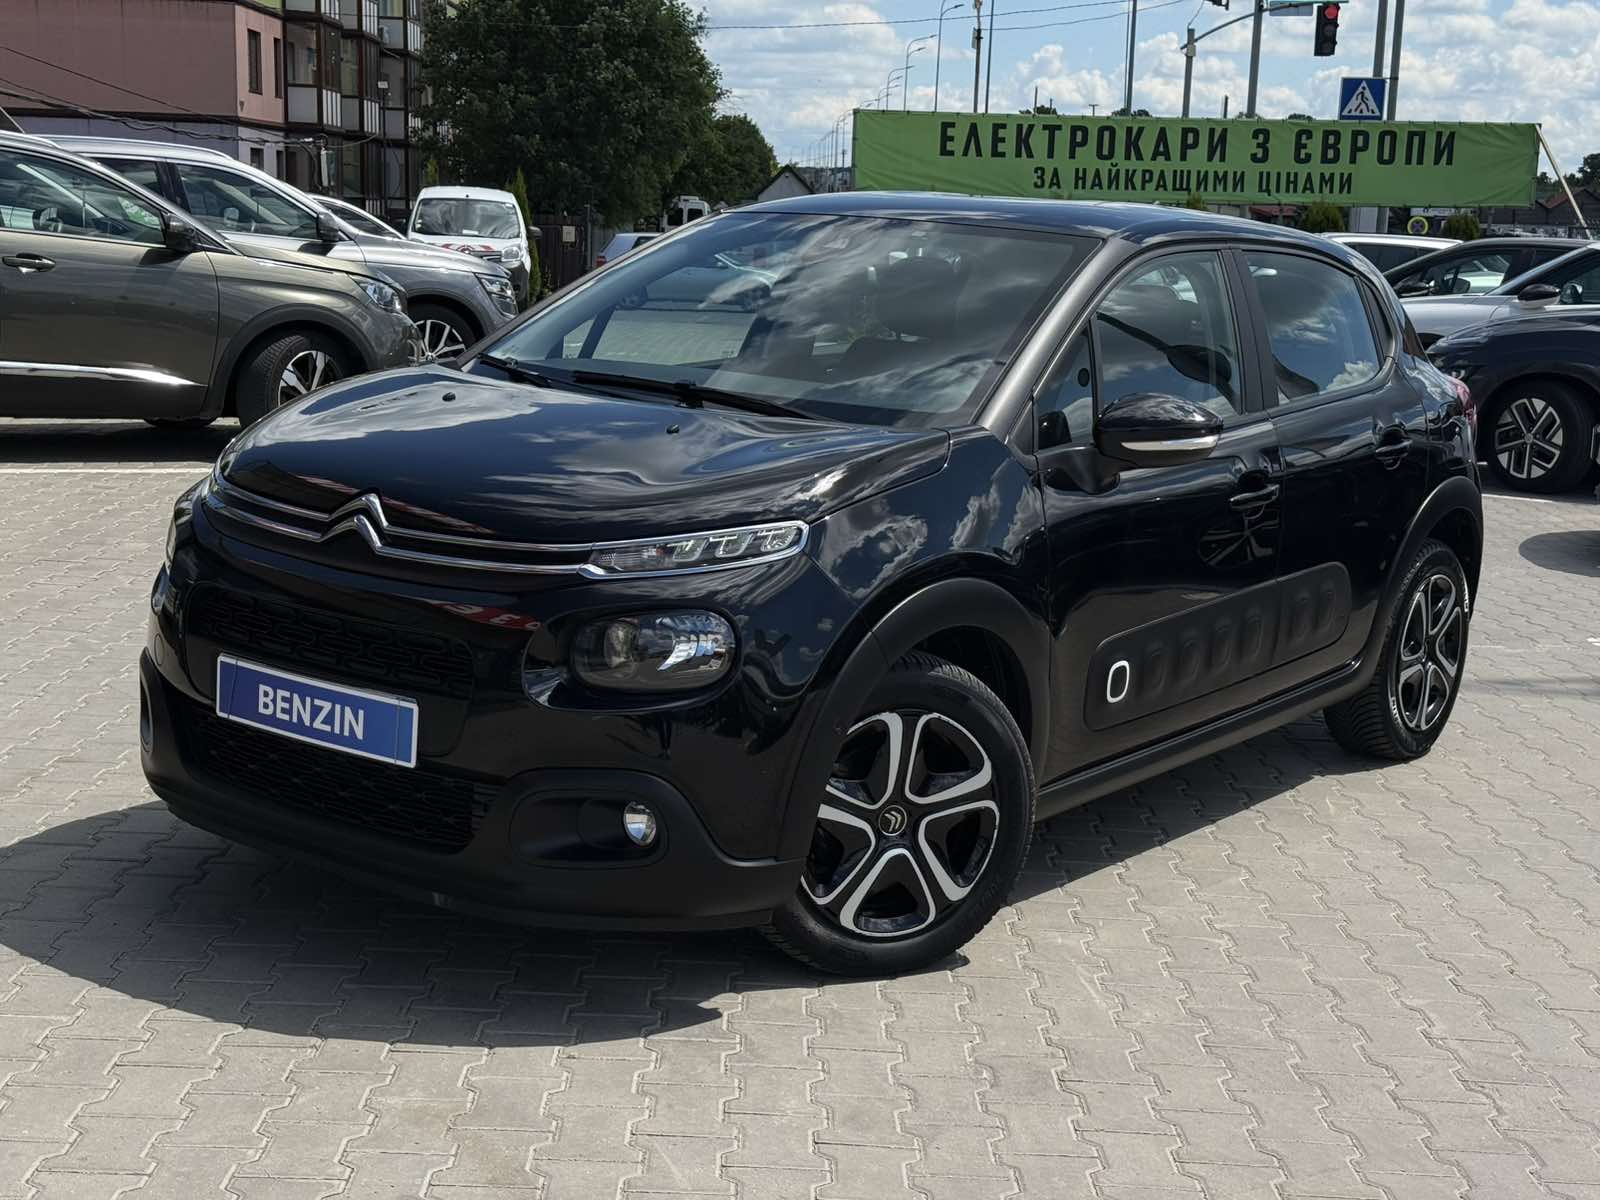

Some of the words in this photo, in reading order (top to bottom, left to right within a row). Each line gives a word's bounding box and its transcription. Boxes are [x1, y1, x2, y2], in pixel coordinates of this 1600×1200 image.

[938, 121, 1228, 162] ЕЛЕКТРОКАРИ
[1250, 128, 1270, 164] З
[1293, 129, 1457, 166] ЄВРОПИ
[1033, 167, 1062, 189] ЗА
[1073, 163, 1245, 194] НАЙКРАЩИМИ
[1258, 171, 1353, 197] ЦІНАМИ
[258, 684, 364, 740] BENZIN
